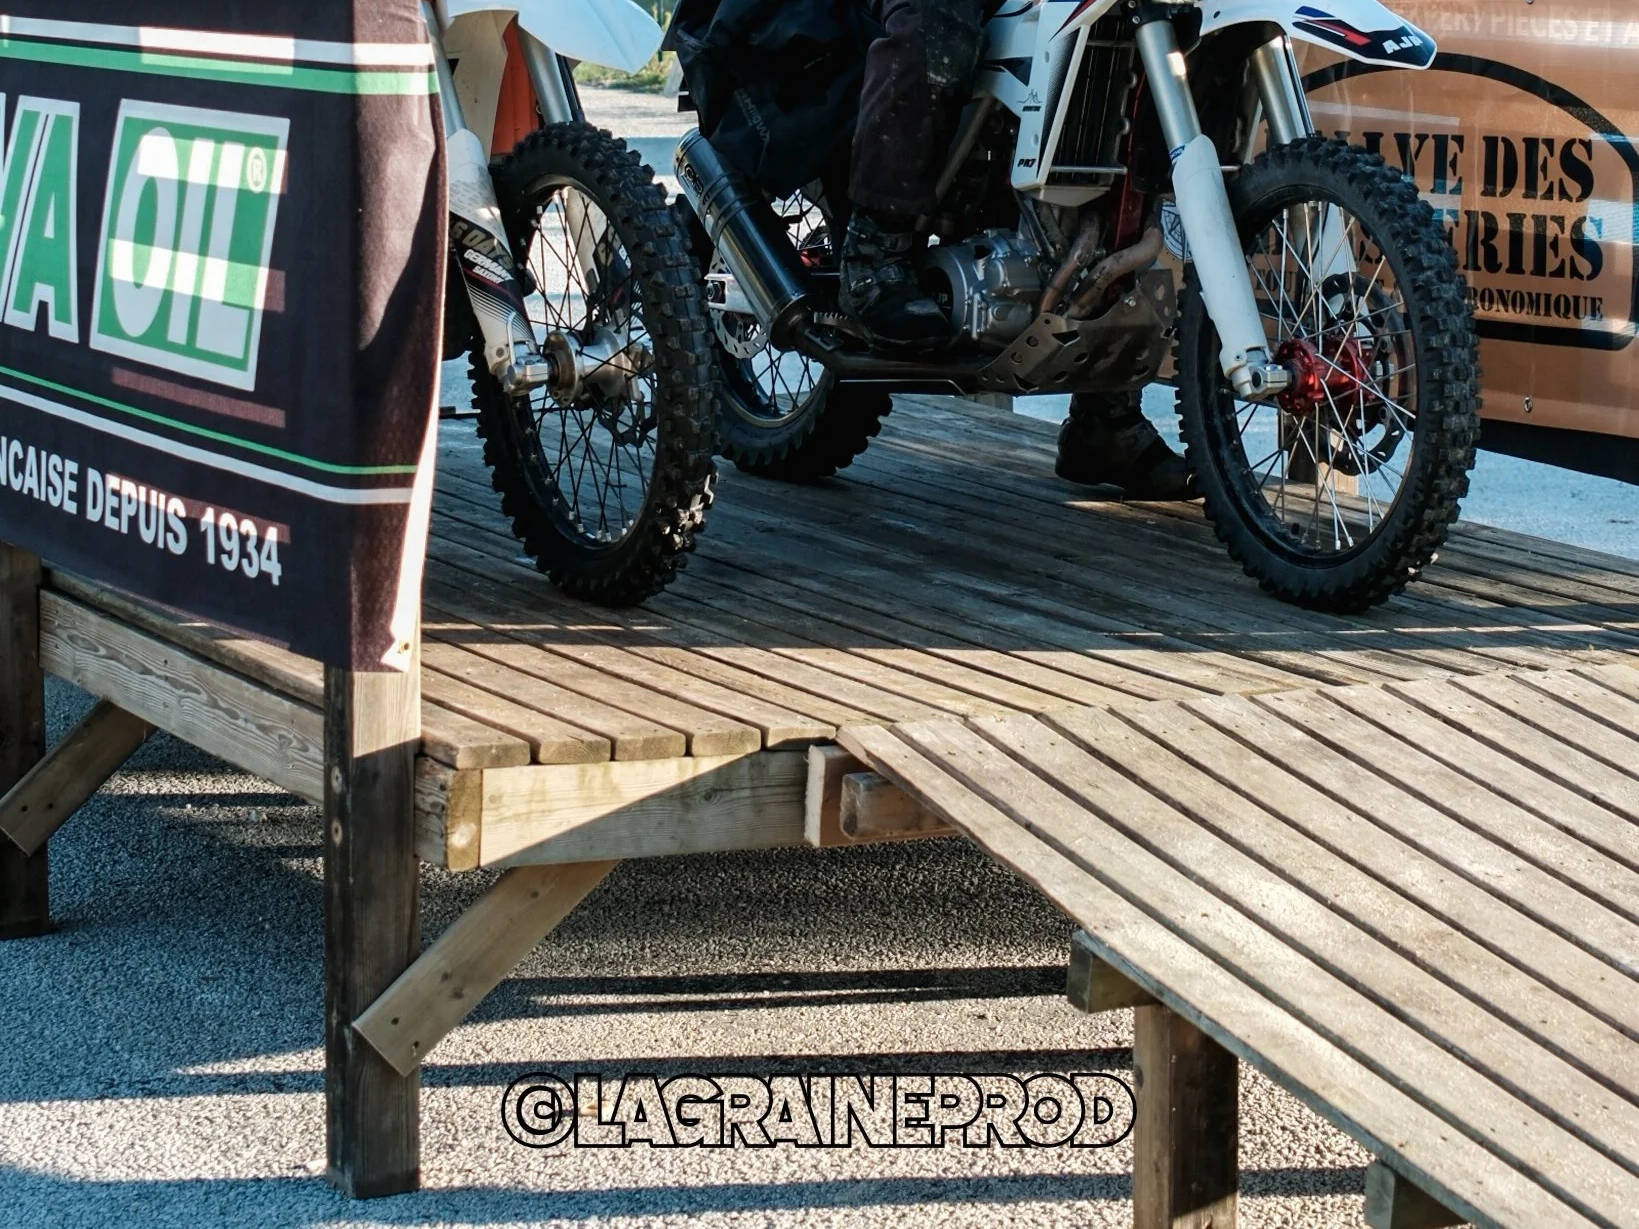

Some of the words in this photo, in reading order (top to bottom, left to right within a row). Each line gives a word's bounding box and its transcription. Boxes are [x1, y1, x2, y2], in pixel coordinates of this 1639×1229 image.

[1480, 135, 1595, 204] DES
[86, 467, 188, 556] DEPUIS
[199, 506, 282, 587] 1934
